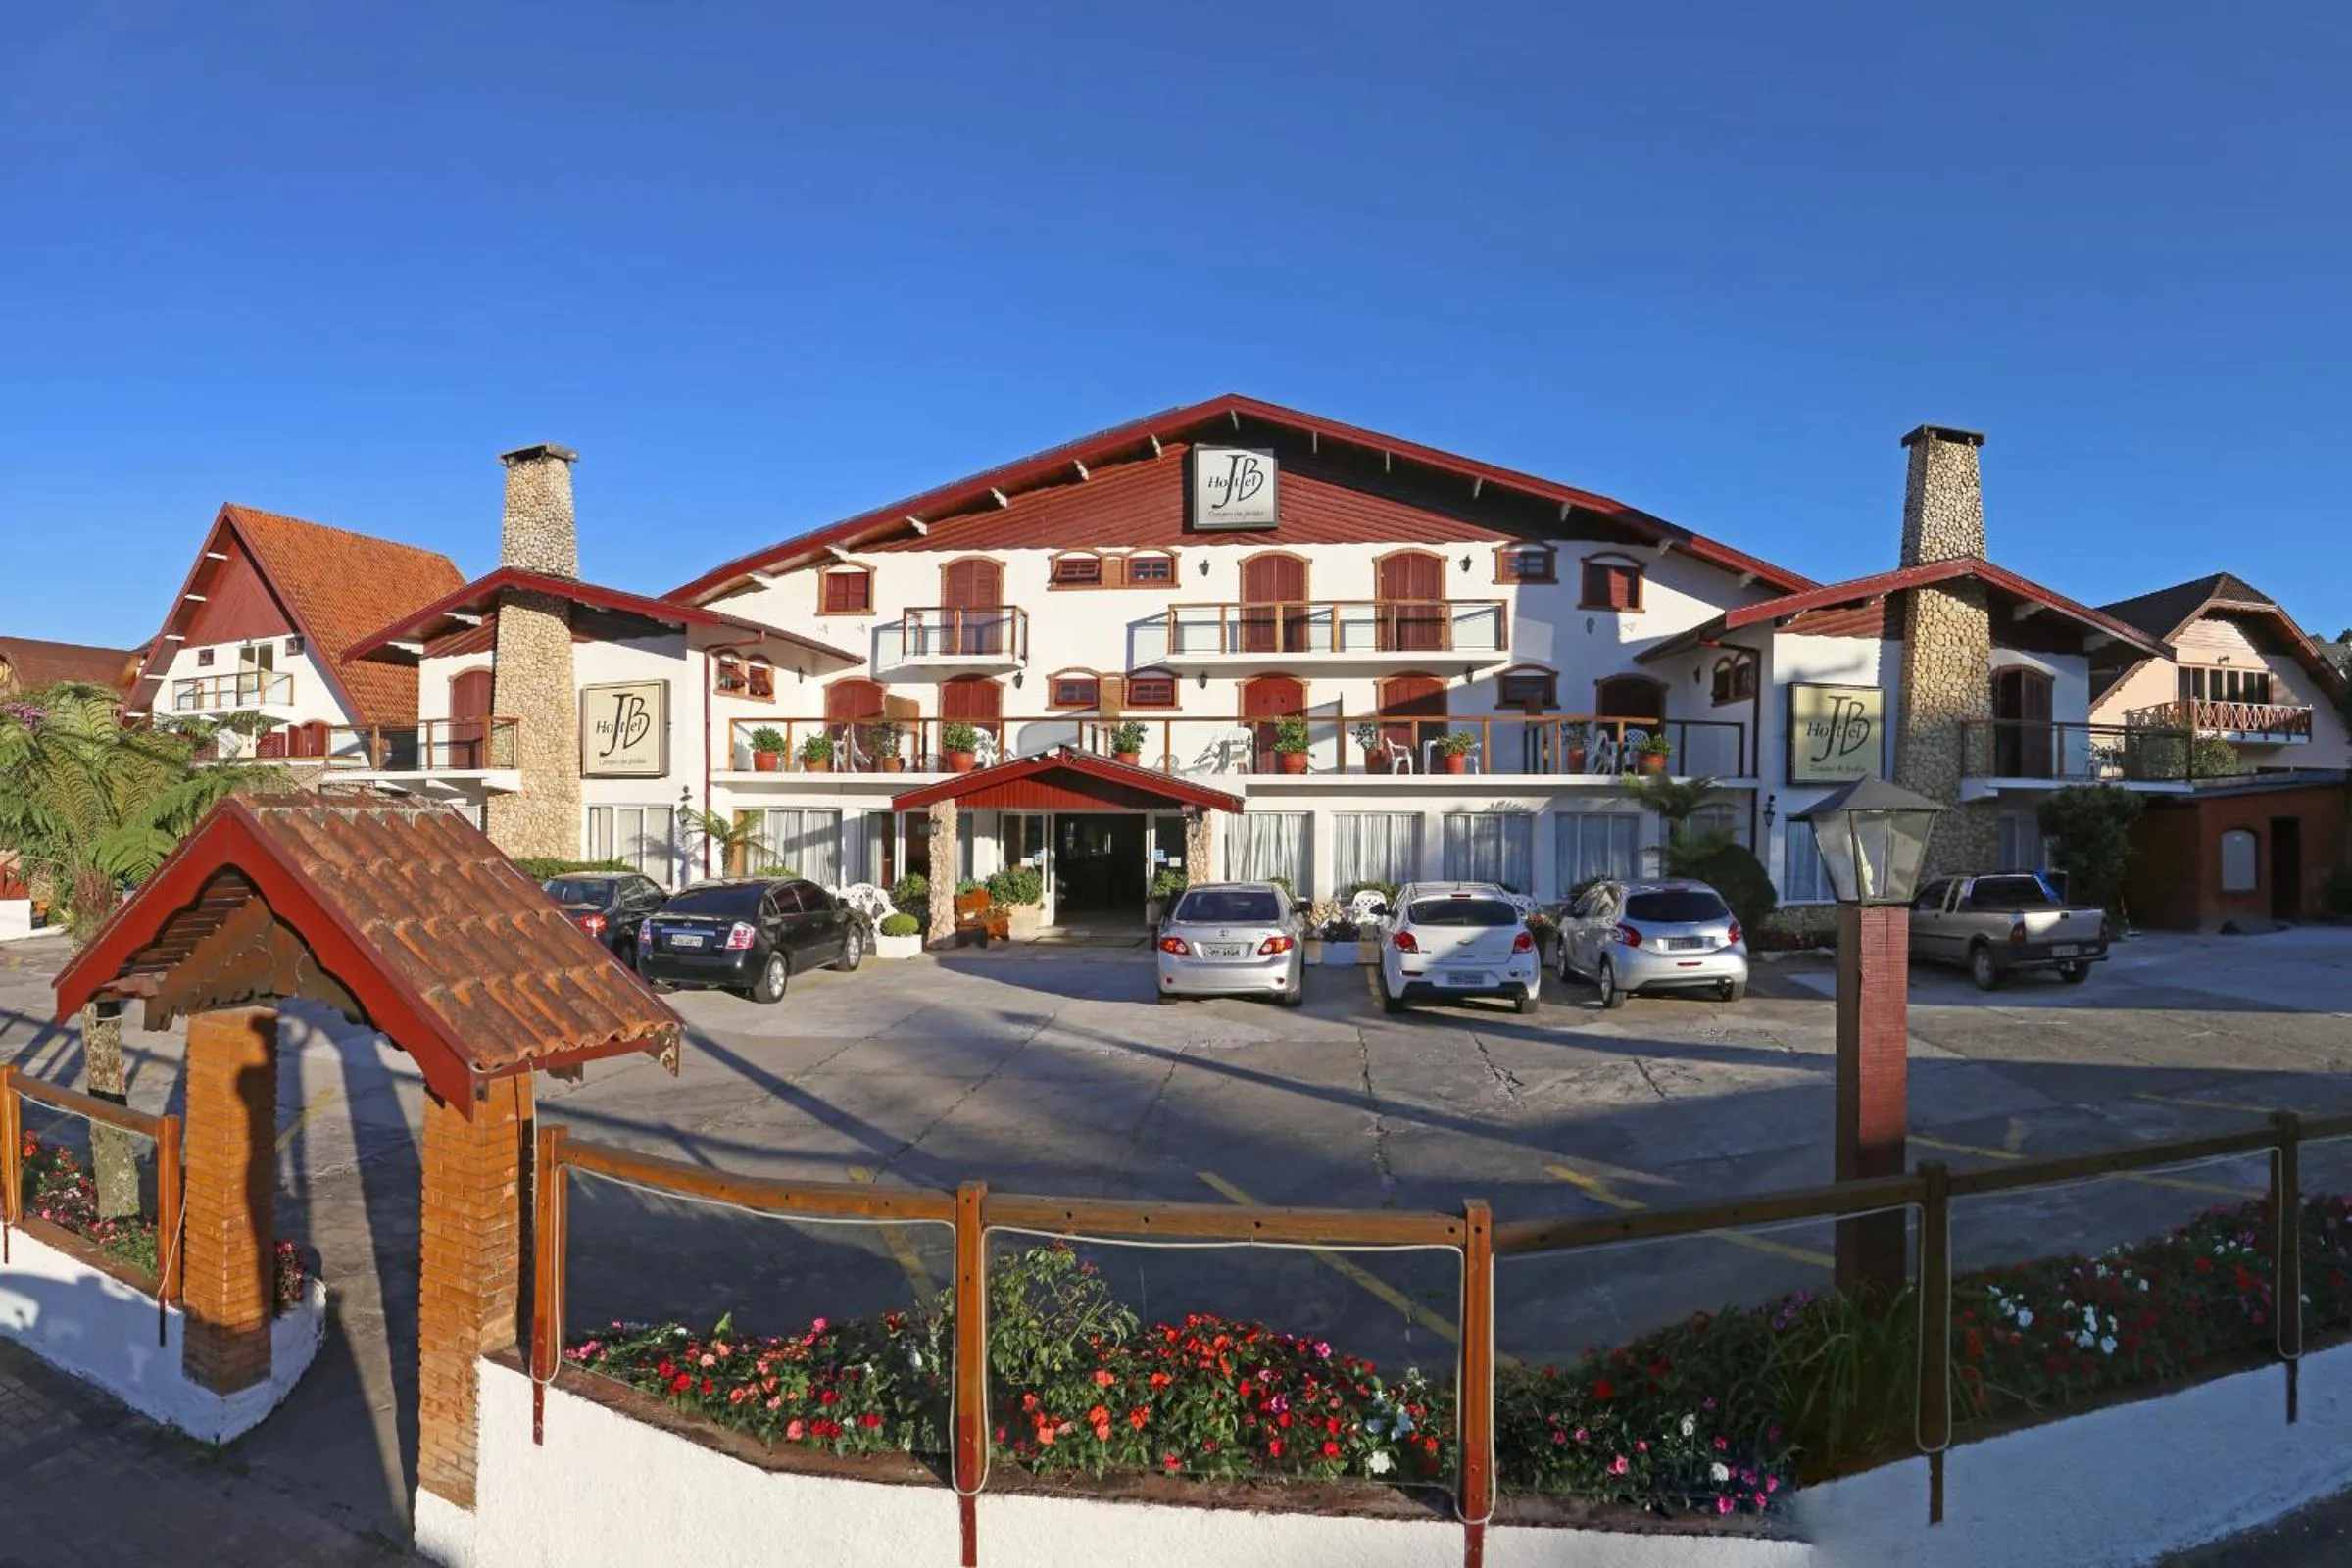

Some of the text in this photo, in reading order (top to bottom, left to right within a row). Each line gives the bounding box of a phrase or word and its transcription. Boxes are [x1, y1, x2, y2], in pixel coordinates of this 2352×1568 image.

[1211, 454, 1264, 509] JB
[599, 693, 650, 757] JB
[1810, 695, 1871, 762] JB
